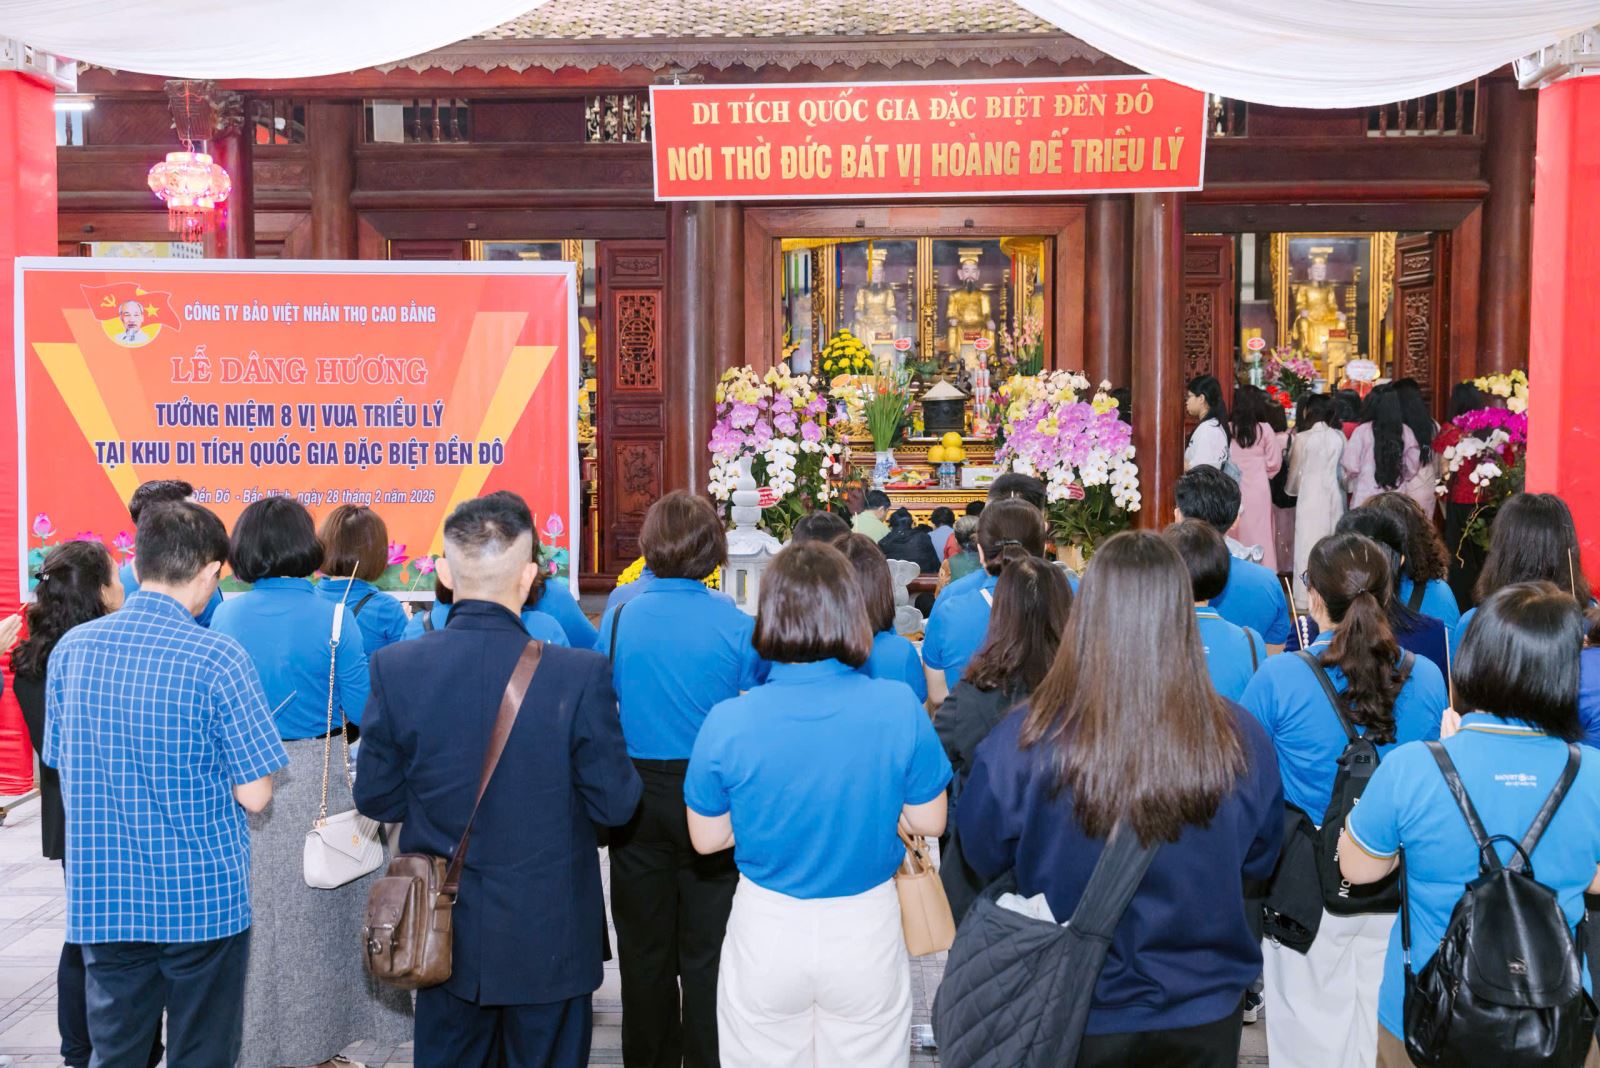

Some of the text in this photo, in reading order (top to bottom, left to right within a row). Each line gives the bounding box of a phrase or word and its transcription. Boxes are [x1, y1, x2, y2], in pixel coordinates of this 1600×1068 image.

[692, 82, 1154, 127] DI TÍCH QUỐC GIA ĐẶC BIỆT ĐỀN ĐÔ
[667, 125, 1185, 186] NƠI THỜ ĐỨC BÁT VỊ HOÀNG ĐẾ TRIỀU LÝ
[184, 299, 436, 326] CÔNG TY BẢO VIỆT NHÂN THỌ CAO BẰNG
[171, 345, 428, 385] LỄ DÂNG HƯƠNG
[155, 396, 444, 432] TƯỞNG NIỆM 8 VỊ VUA TRIỀU LÝ
[95, 434, 504, 470] TẠI KHU DI TÍCH QUỐC GIA ĐẶC BIỆT ĐỀN ĐÔ
[215, 489, 230, 503] Đô
[242, 486, 263, 503] Bắc
[297, 489, 323, 506] ngày
[326, 489, 339, 504] 28
[342, 489, 372, 505] tháng
[375, 490, 382, 503] 2
[384, 489, 407, 503] năm
[410, 490, 436, 503] 2026
